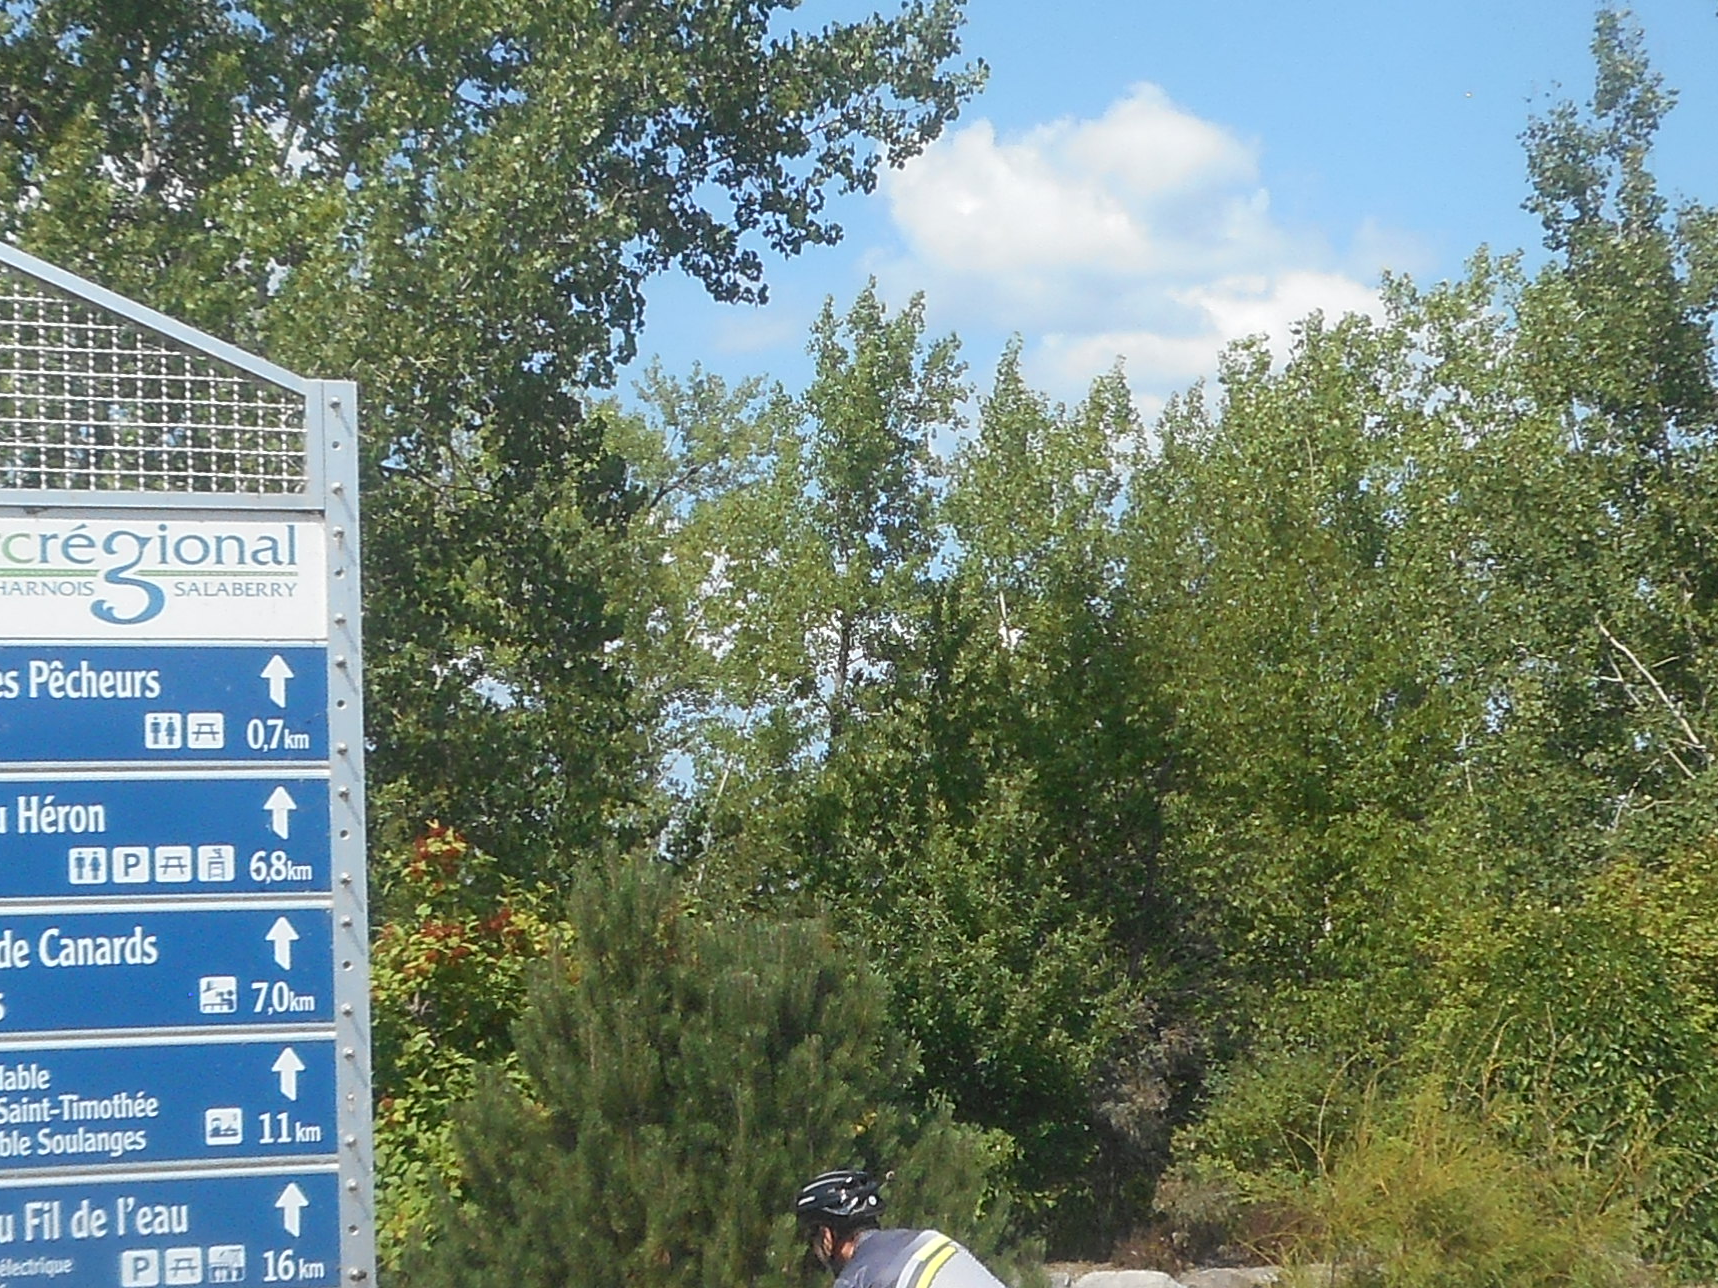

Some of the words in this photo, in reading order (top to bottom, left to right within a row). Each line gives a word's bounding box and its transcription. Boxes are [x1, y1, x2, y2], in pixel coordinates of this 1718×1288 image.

[174, 580, 298, 597] SALABERRY
[29, 660, 161, 699] Pêcheurs
[18, 795, 106, 833] Héron
[38, 926, 159, 968] Canards
[37, 1126, 147, 1161] Soulanges
[258, 1112, 292, 1144] 11
[295, 1121, 322, 1144] km
[25, 1200, 61, 1243] Fil
[70, 1198, 107, 1240] de
[117, 1196, 188, 1236] l'eau
[262, 1250, 294, 1282] 16
[298, 1258, 325, 1281] km
